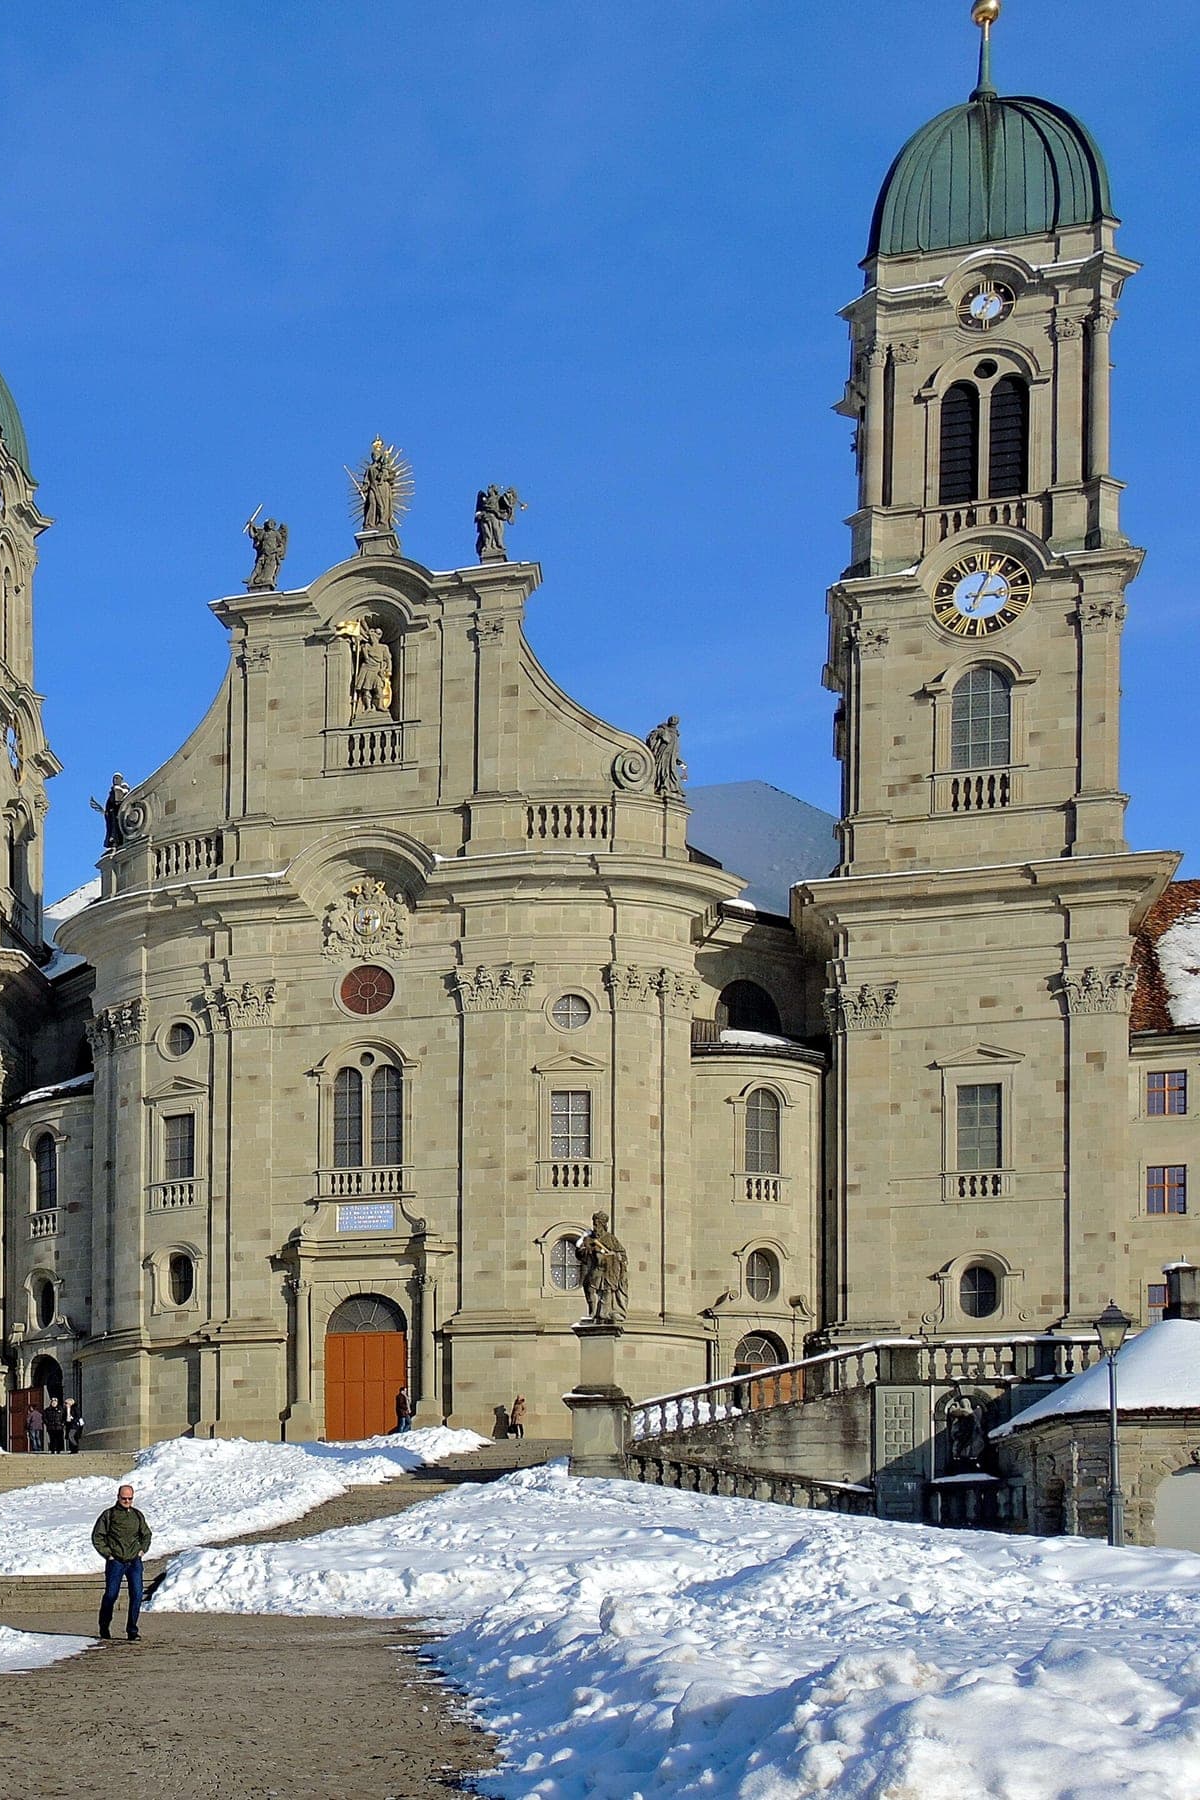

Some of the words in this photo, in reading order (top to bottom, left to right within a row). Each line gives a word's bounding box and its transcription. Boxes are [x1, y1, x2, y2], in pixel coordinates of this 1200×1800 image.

[975, 552, 990, 571] XII
[954, 560, 970, 576] XI
[1007, 568, 1025, 580] II
[939, 579, 958, 587] X
[1010, 585, 1030, 595] III
[934, 596, 953, 605] IX
[996, 614, 1008, 627] V
[976, 618, 987, 636] VI
